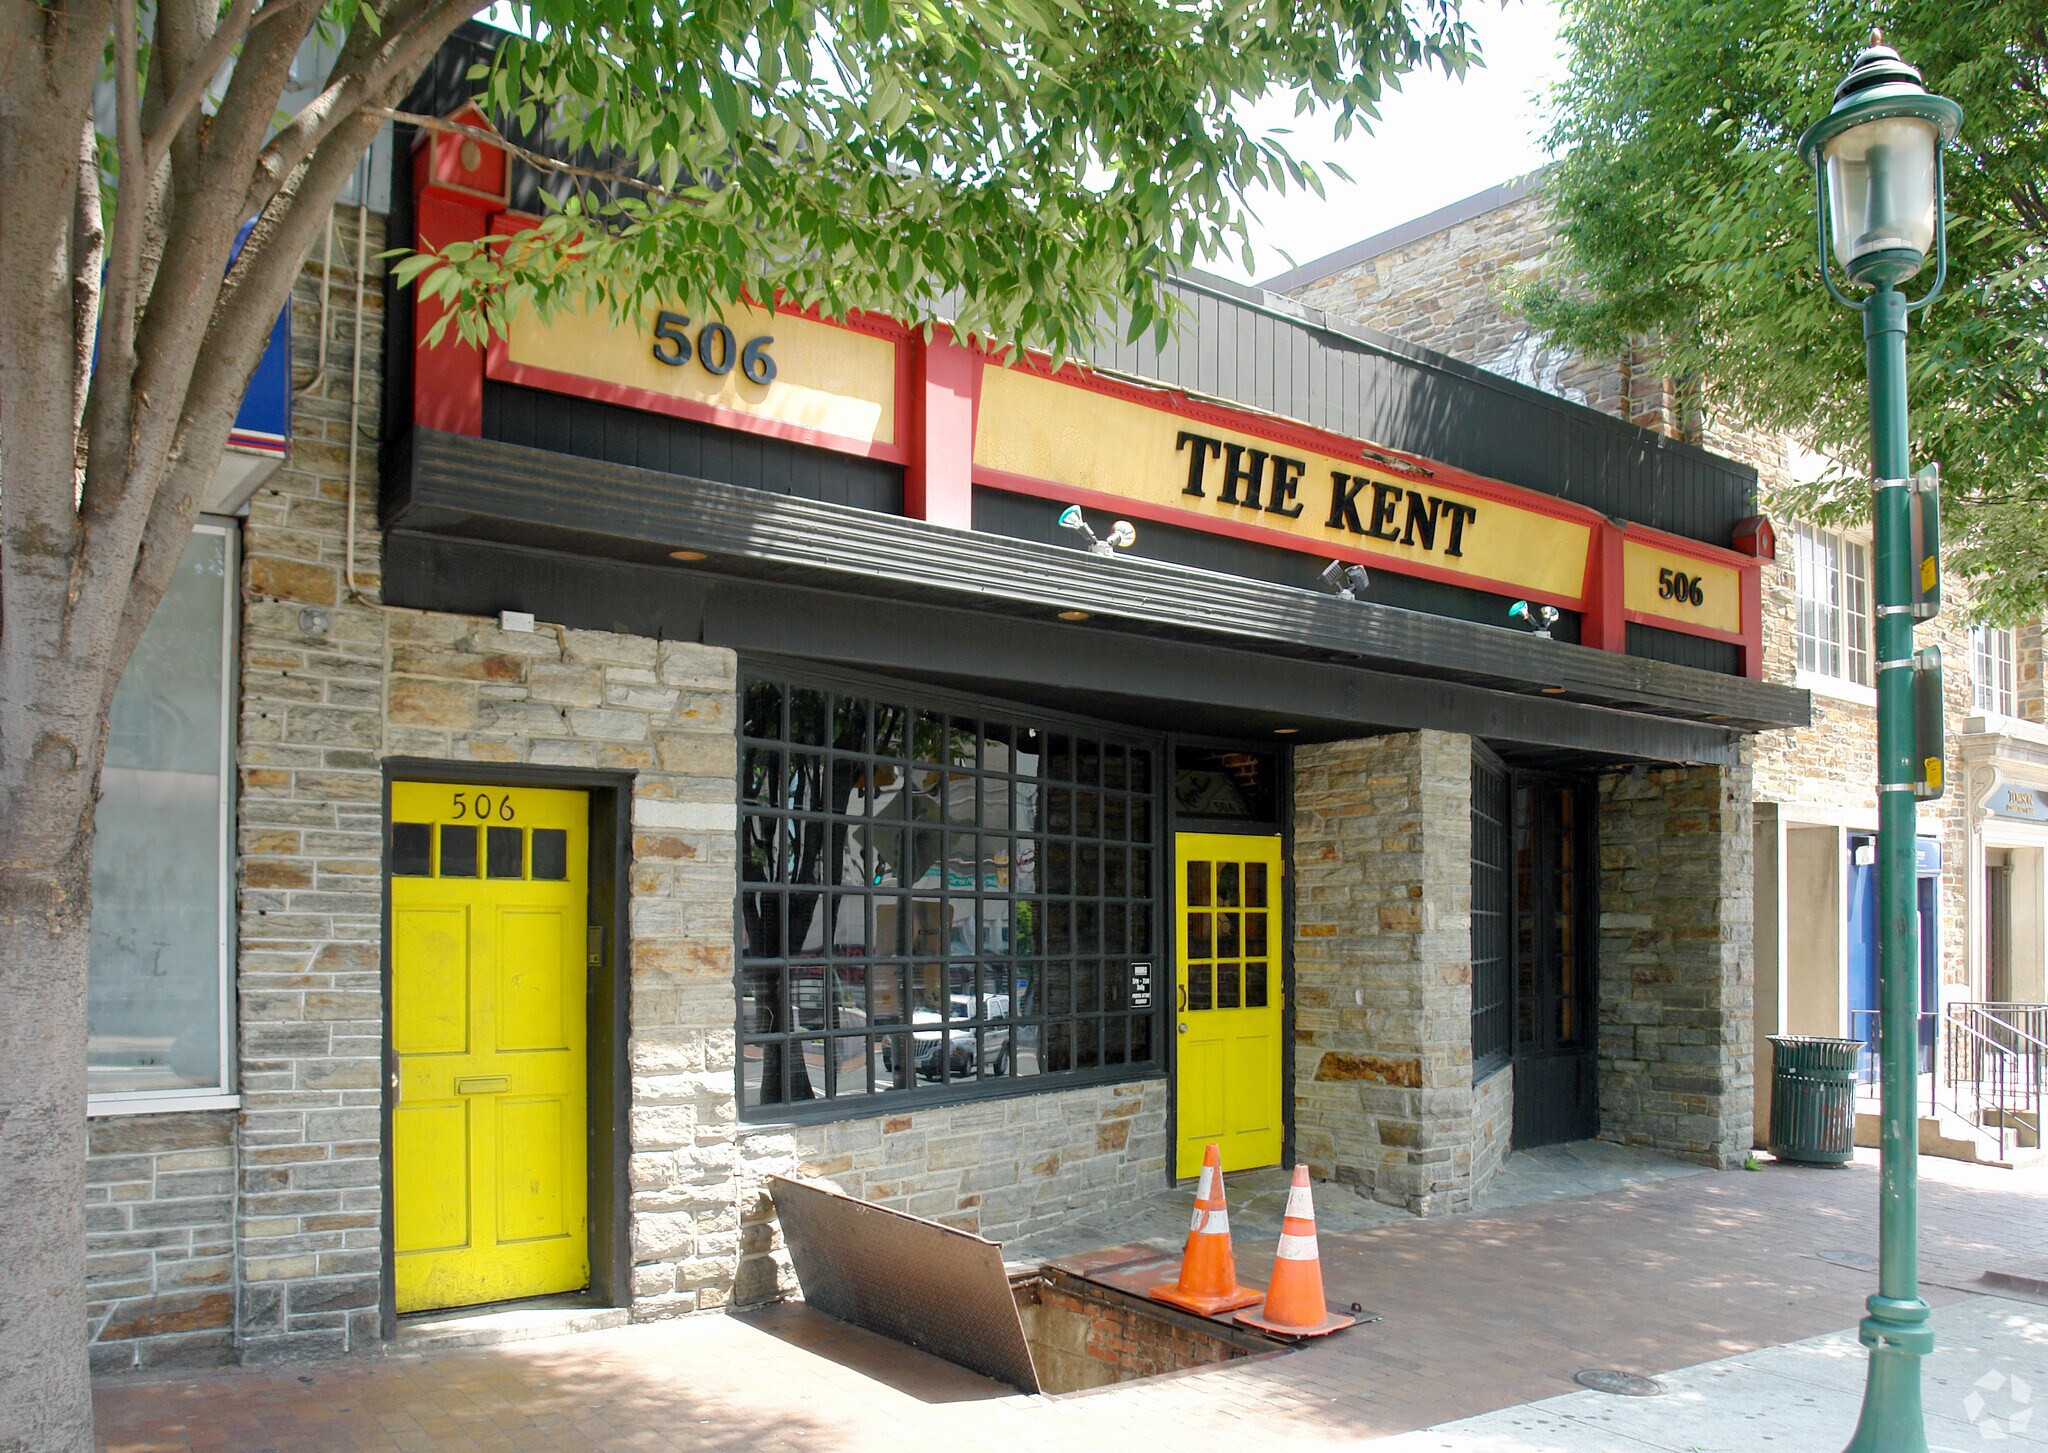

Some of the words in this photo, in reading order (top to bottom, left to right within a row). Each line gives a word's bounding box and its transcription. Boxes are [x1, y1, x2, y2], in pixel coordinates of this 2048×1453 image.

[653, 310, 777, 385] 506
[1176, 430, 1306, 519] THE
[1324, 470, 1477, 558] KENT
[1658, 567, 1704, 607] 506
[451, 792, 515, 822] 506
